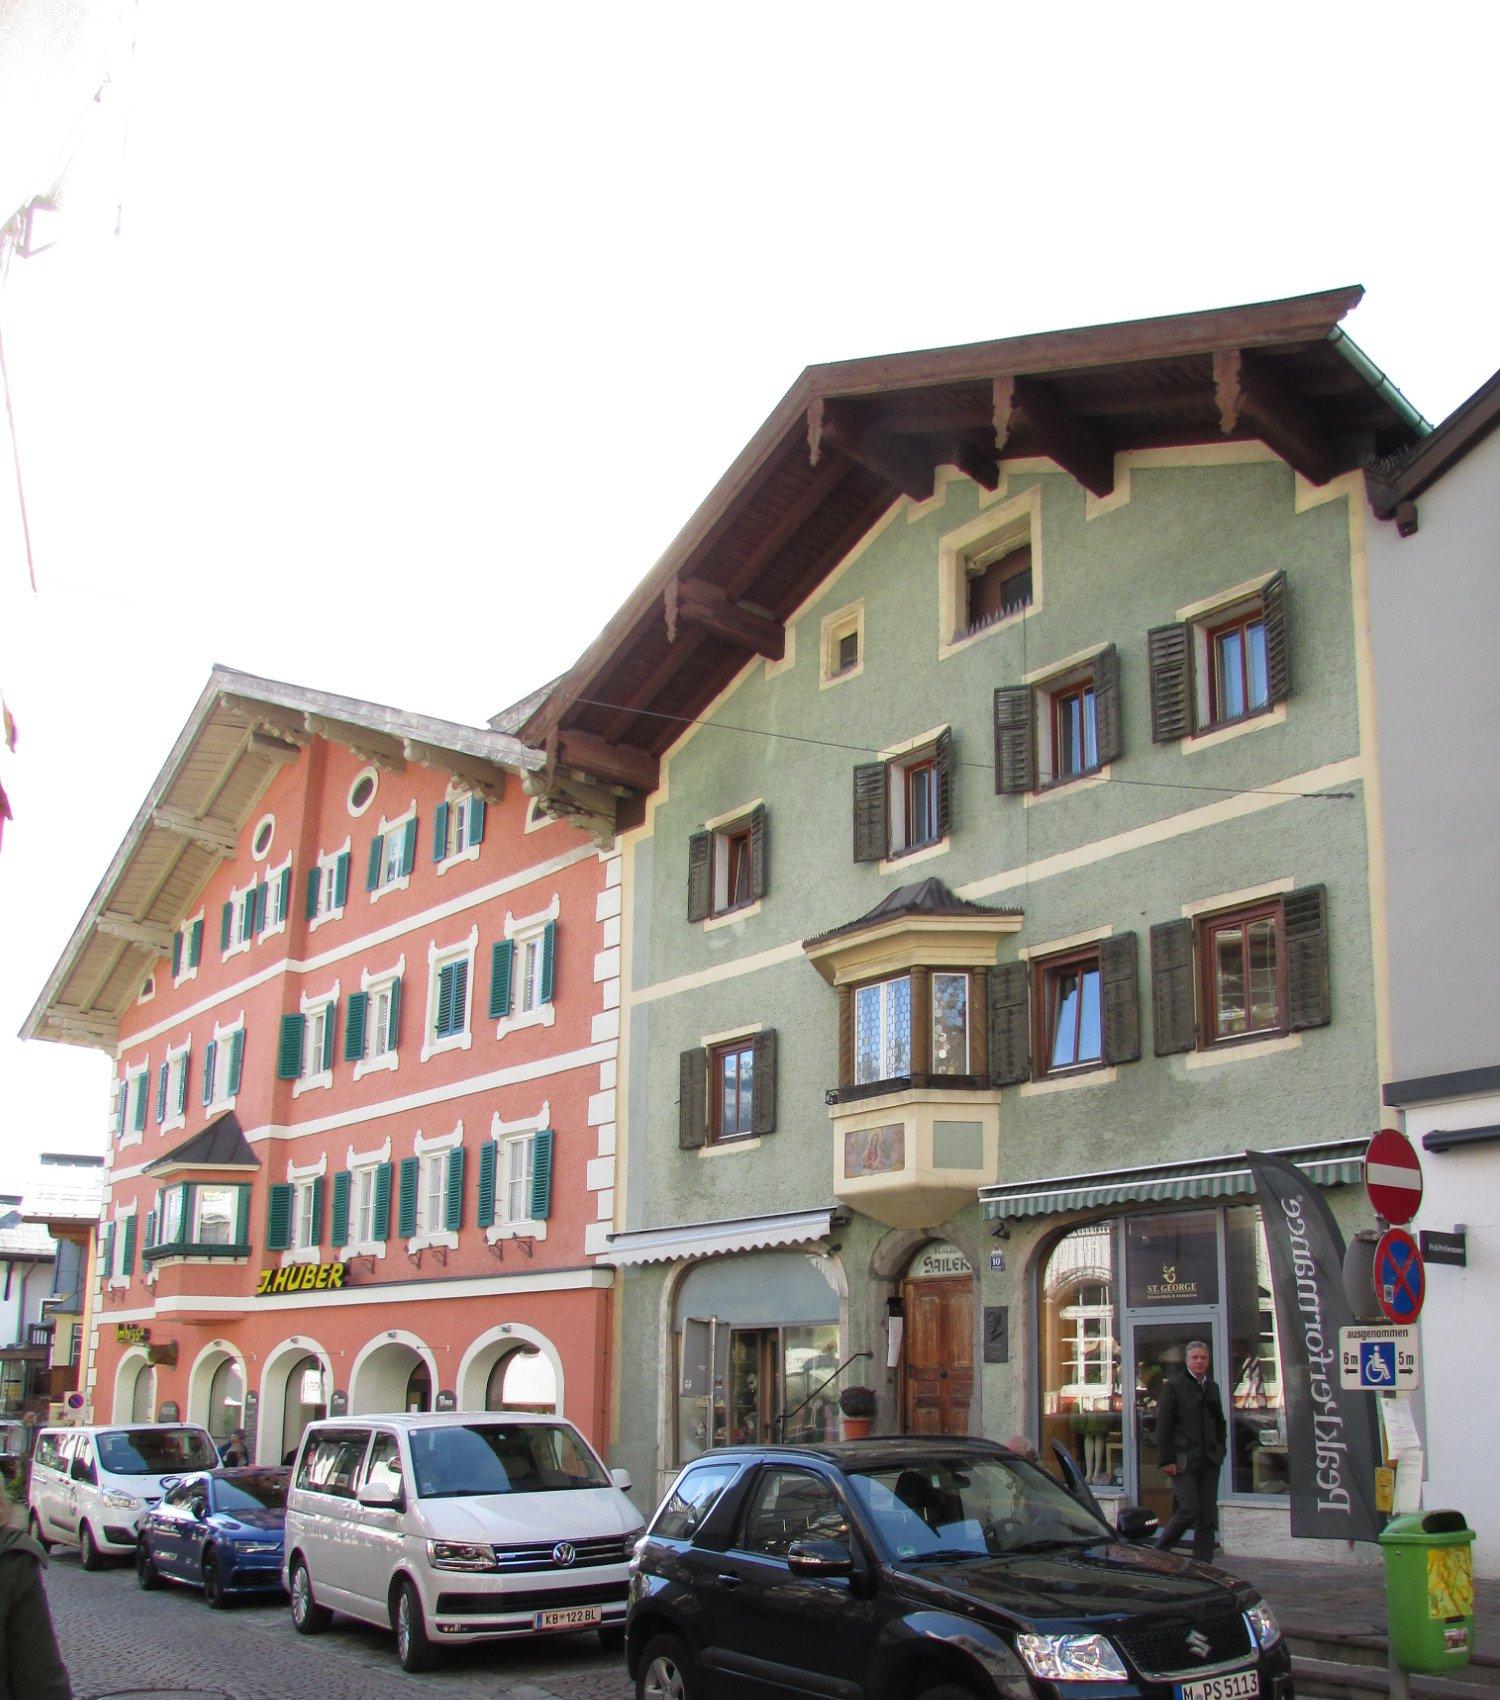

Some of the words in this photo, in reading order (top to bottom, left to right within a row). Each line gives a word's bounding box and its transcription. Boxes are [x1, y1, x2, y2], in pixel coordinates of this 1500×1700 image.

[923, 1256, 970, 1273] SAILER
[992, 1258, 1002, 1266] 10
[257, 1263, 344, 1294] J.HUBER
[1160, 1282, 1197, 1292] GEORGE
[1346, 1329, 1408, 1340] ausgenommen
[1343, 1352, 1349, 1365] 6
[1350, 1355, 1358, 1365] m
[1398, 1351, 1404, 1365] 5
[1406, 1354, 1414, 1365] m
[545, 1613, 558, 1625] KB
[566, 1611, 583, 1623] 122
[585, 1609, 596, 1620] BL
[1224, 1673, 1257, 1698] 5113
